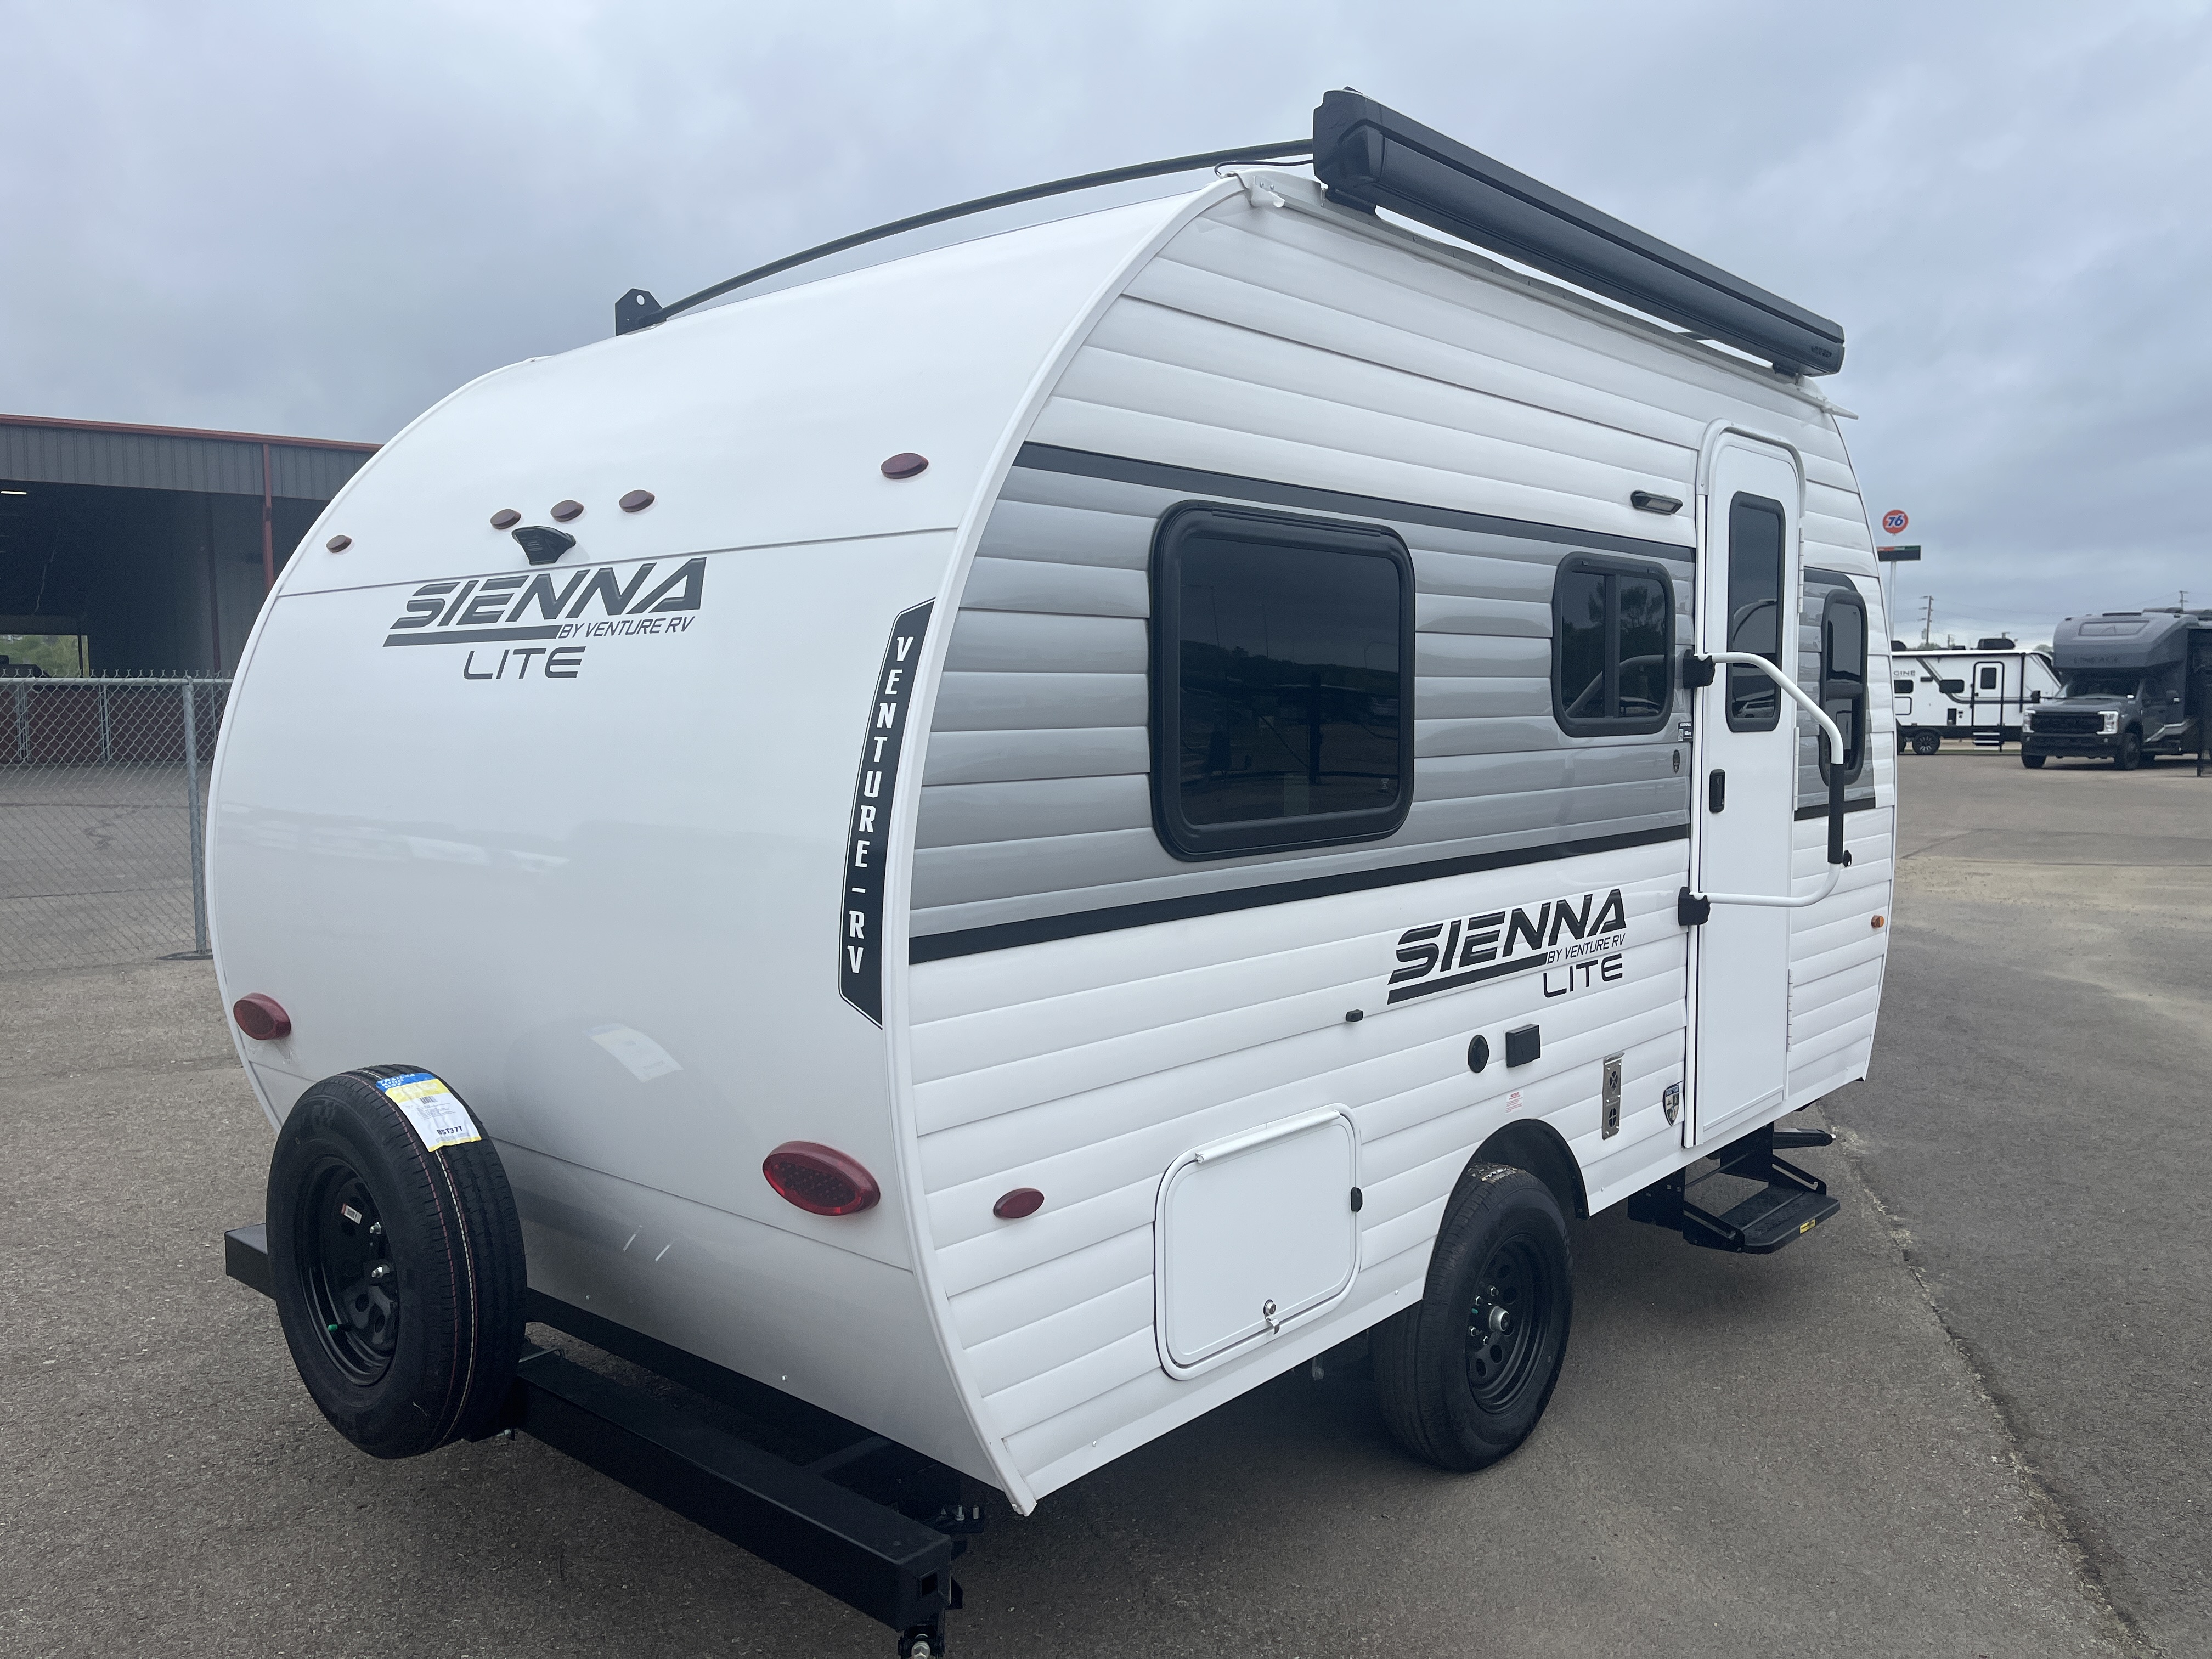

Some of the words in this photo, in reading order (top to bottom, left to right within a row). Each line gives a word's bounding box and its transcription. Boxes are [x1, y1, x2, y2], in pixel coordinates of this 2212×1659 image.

[1887, 515, 1904, 527] 76
[389, 557, 707, 630] SIENNA
[557, 622, 584, 639] BY
[585, 618, 666, 638] VENTURE
[667, 616, 696, 633] RV
[463, 646, 586, 680] LITE
[1387, 888, 1627, 985] SIENNA
[1546, 950, 1563, 965] BY
[1565, 940, 1611, 960] VENTURE
[1611, 933, 1626, 947] RV
[1543, 952, 1623, 998] LITE
